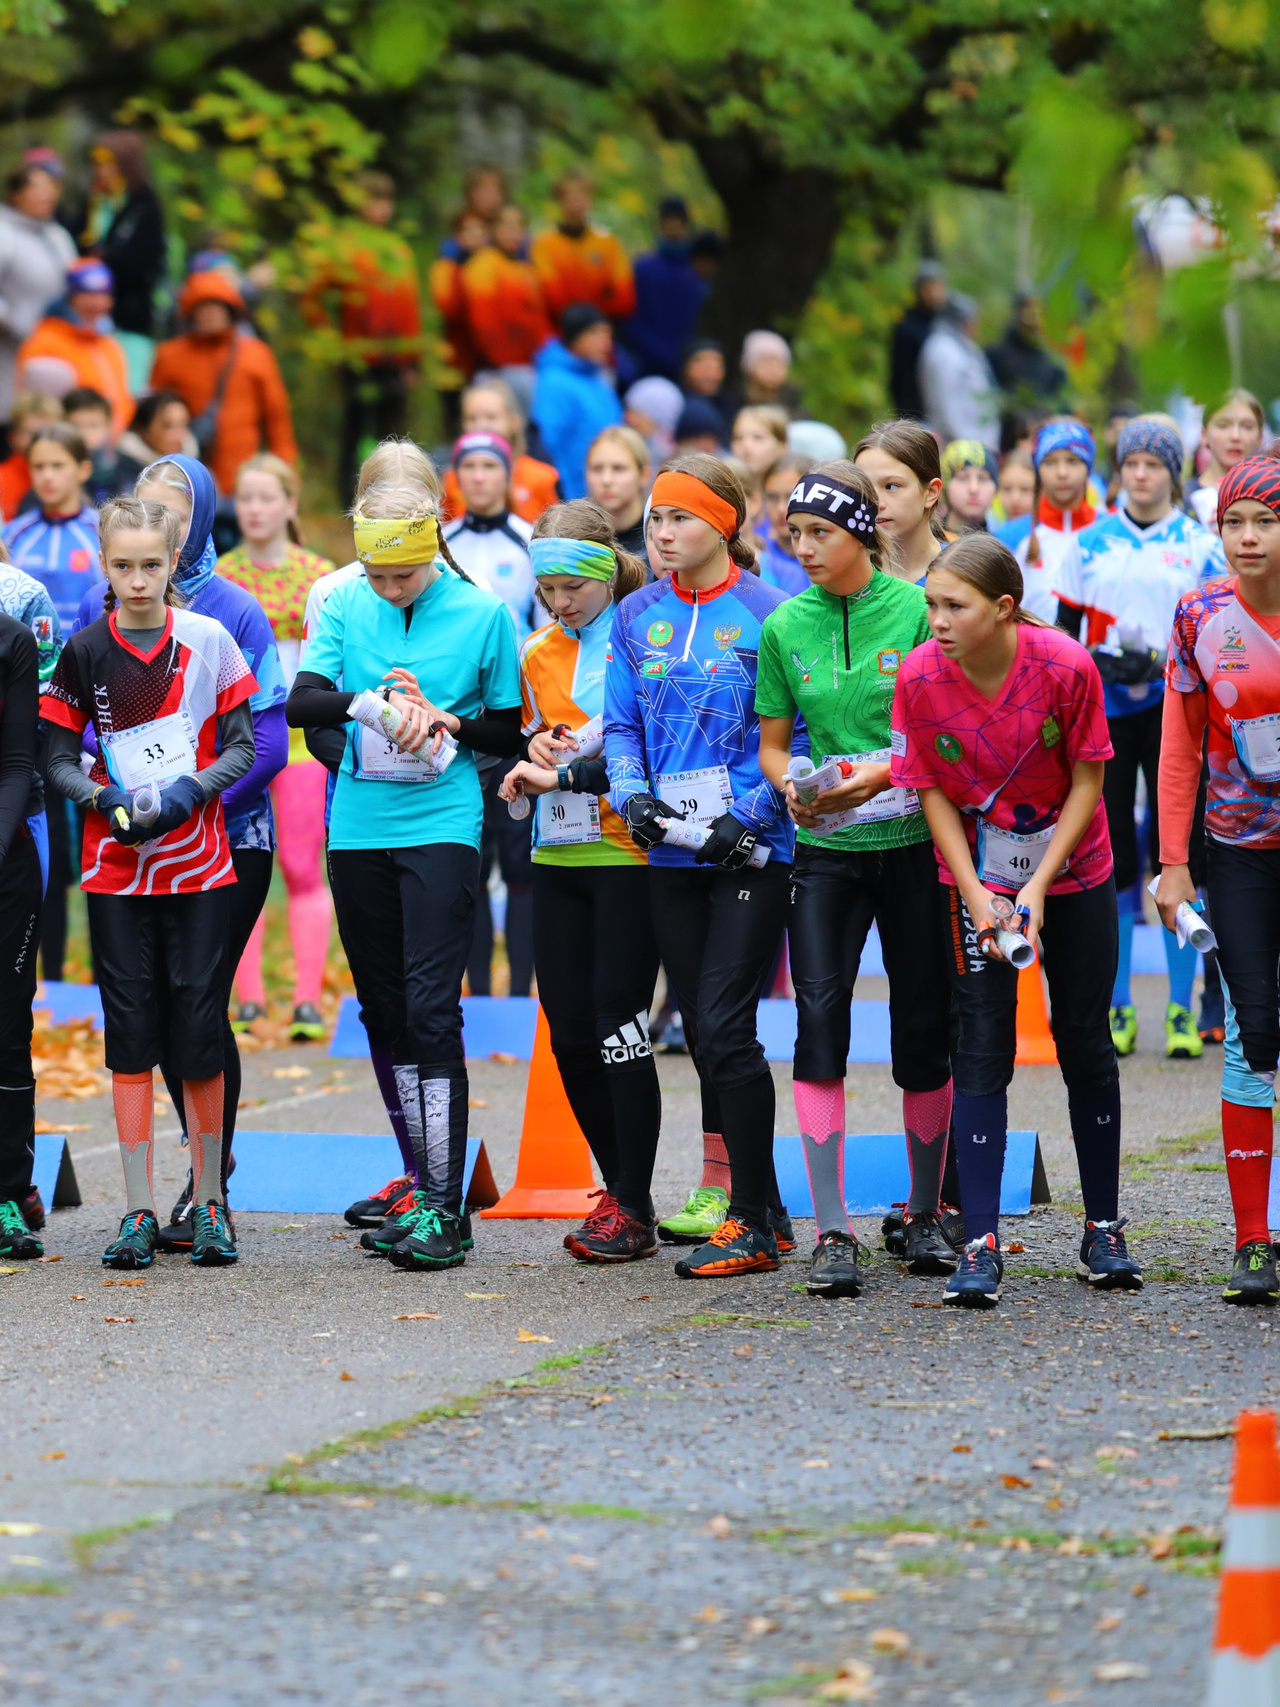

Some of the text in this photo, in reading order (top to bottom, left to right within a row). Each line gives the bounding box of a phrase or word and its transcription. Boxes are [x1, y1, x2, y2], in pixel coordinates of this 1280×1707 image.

[646, 664, 660, 673] SFR
[93, 683, 113, 735] ЕНСК
[143, 743, 165, 764] 33
[551, 805, 565, 822] 30
[680, 799, 698, 815] 29
[1009, 856, 1030, 870] 40
[601, 1040, 654, 1064] adid
